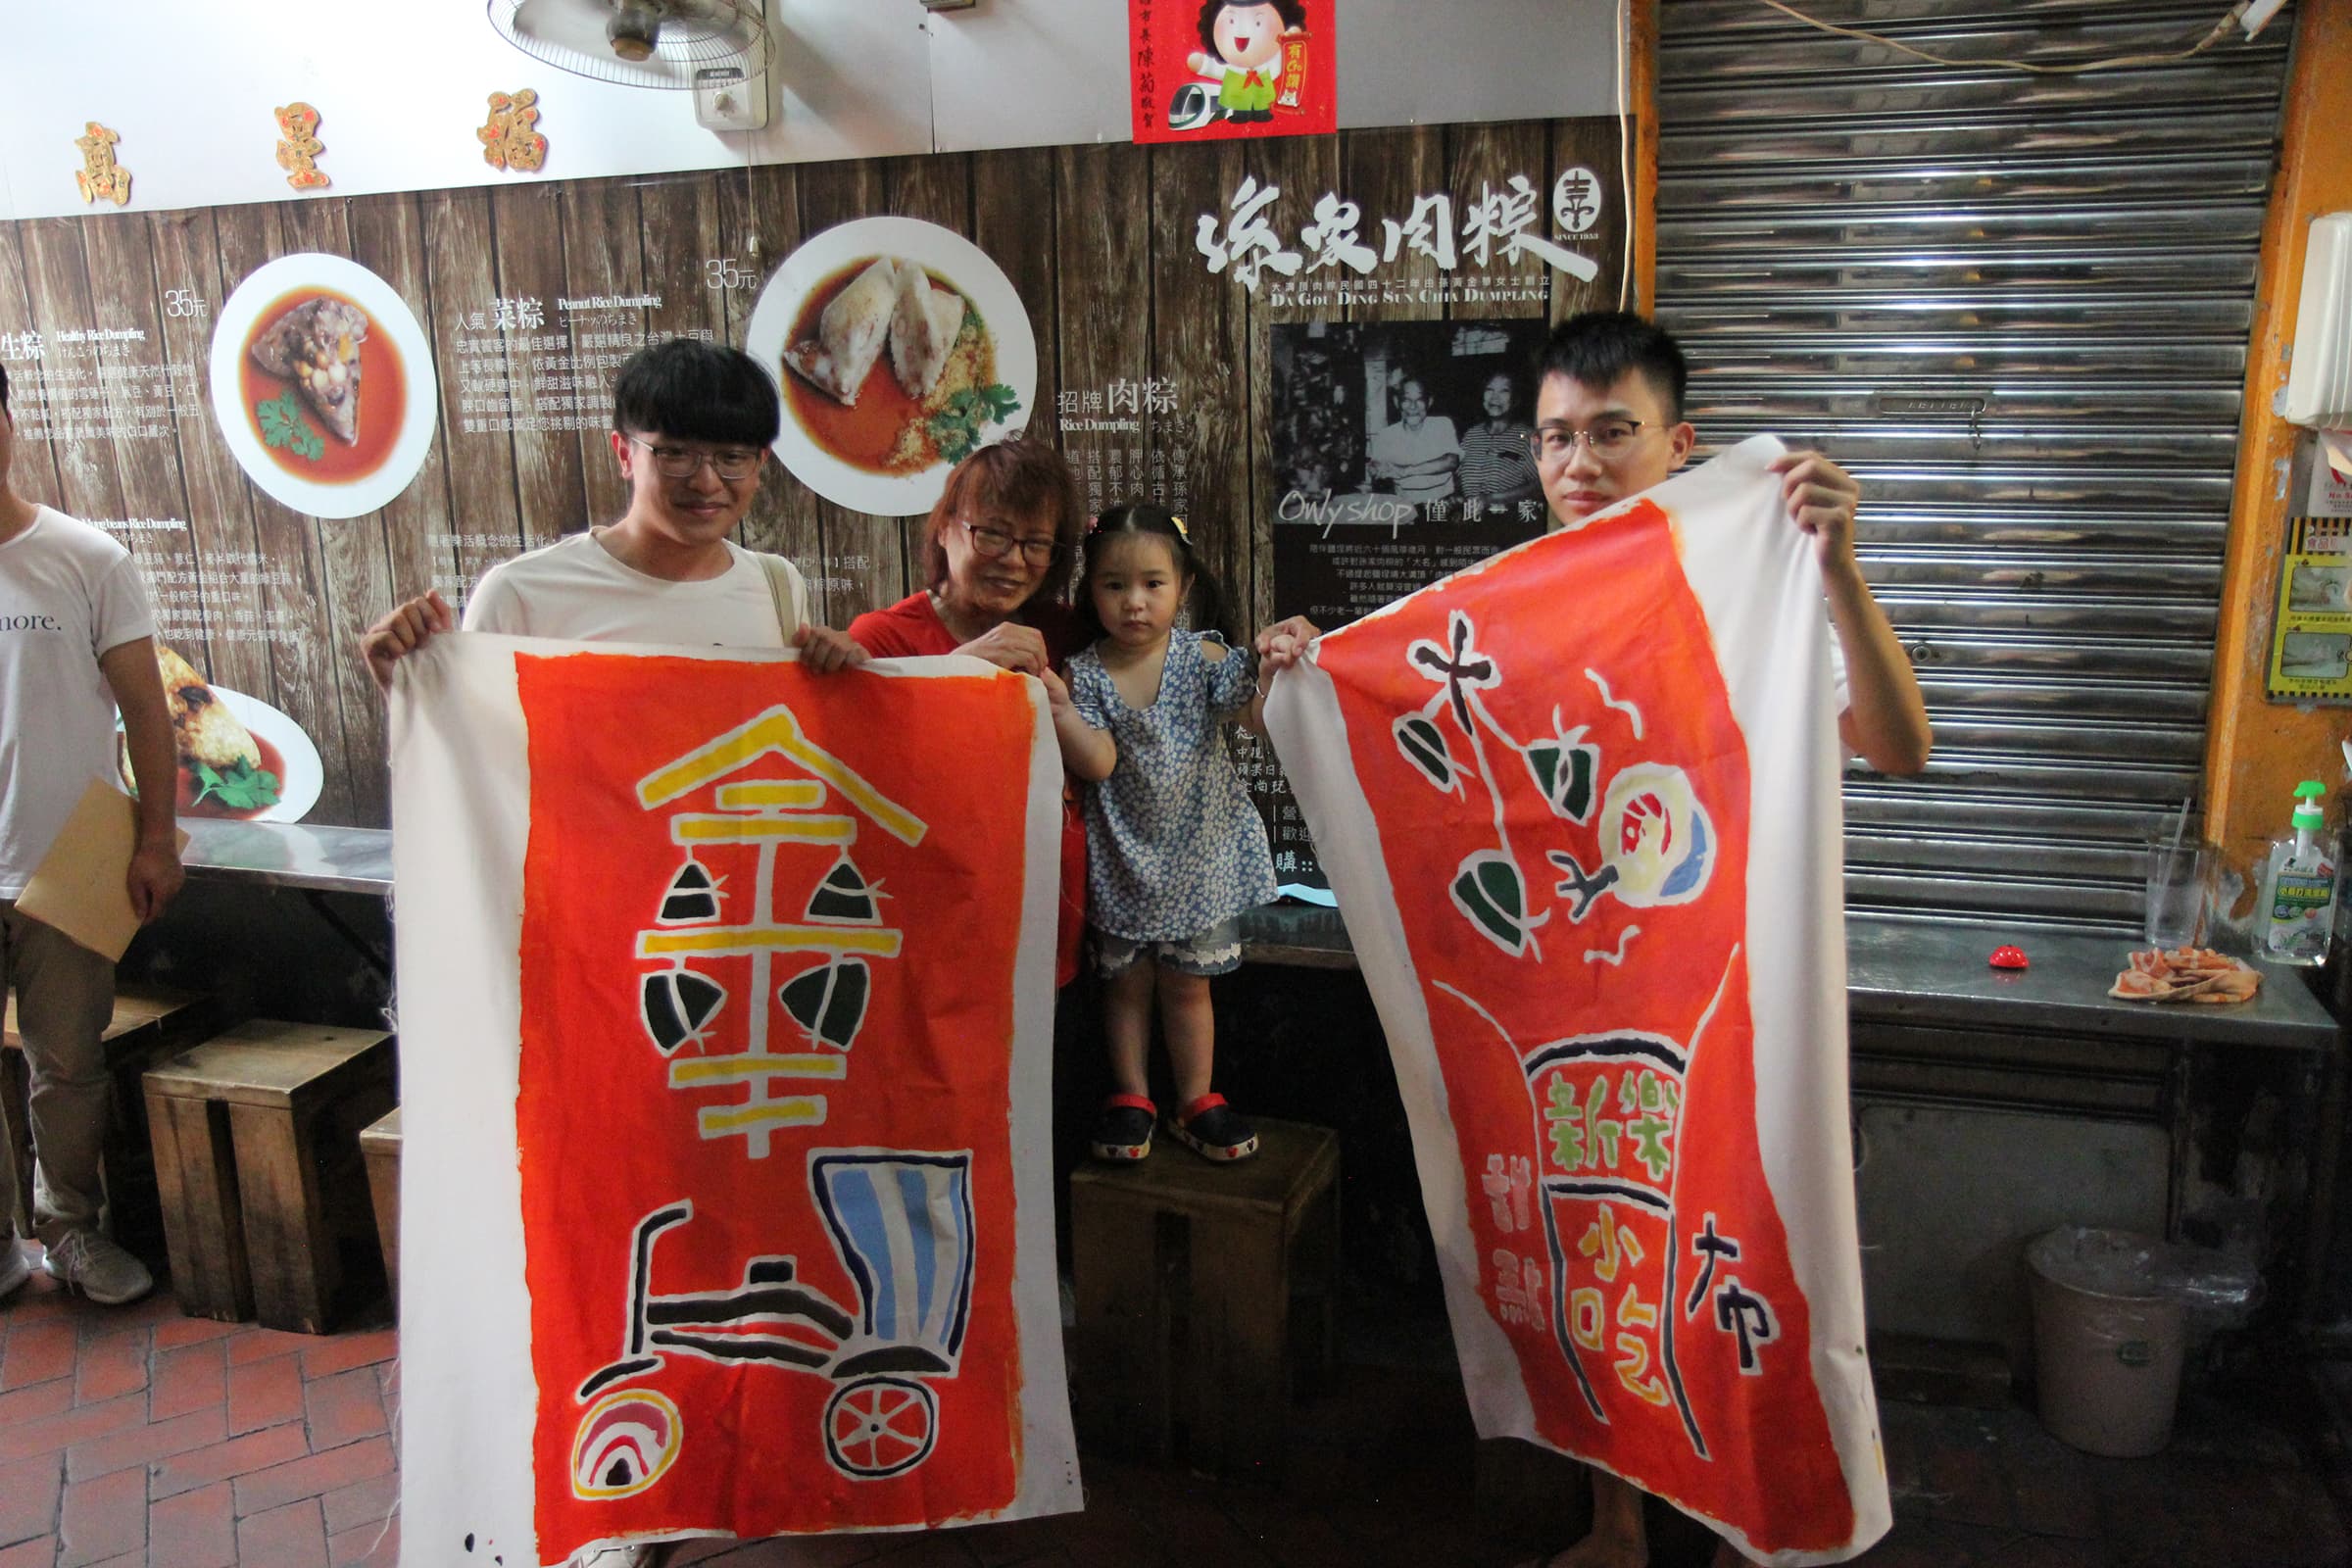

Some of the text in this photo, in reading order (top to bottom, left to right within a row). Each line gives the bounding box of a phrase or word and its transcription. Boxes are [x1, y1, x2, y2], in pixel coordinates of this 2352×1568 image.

[706, 259, 757, 290] 35元
[165, 289, 208, 318] 35元
[558, 293, 662, 311] Peanut Rice Dumpling
[56, 327, 145, 344] Healthy Rice Dumpling
[1057, 376, 1178, 415] 招牌肉粽
[1059, 417, 1140, 434] Rice Dumpling
[146, 516, 187, 531] Dumpling
[1278, 488, 1412, 539] Only shop
